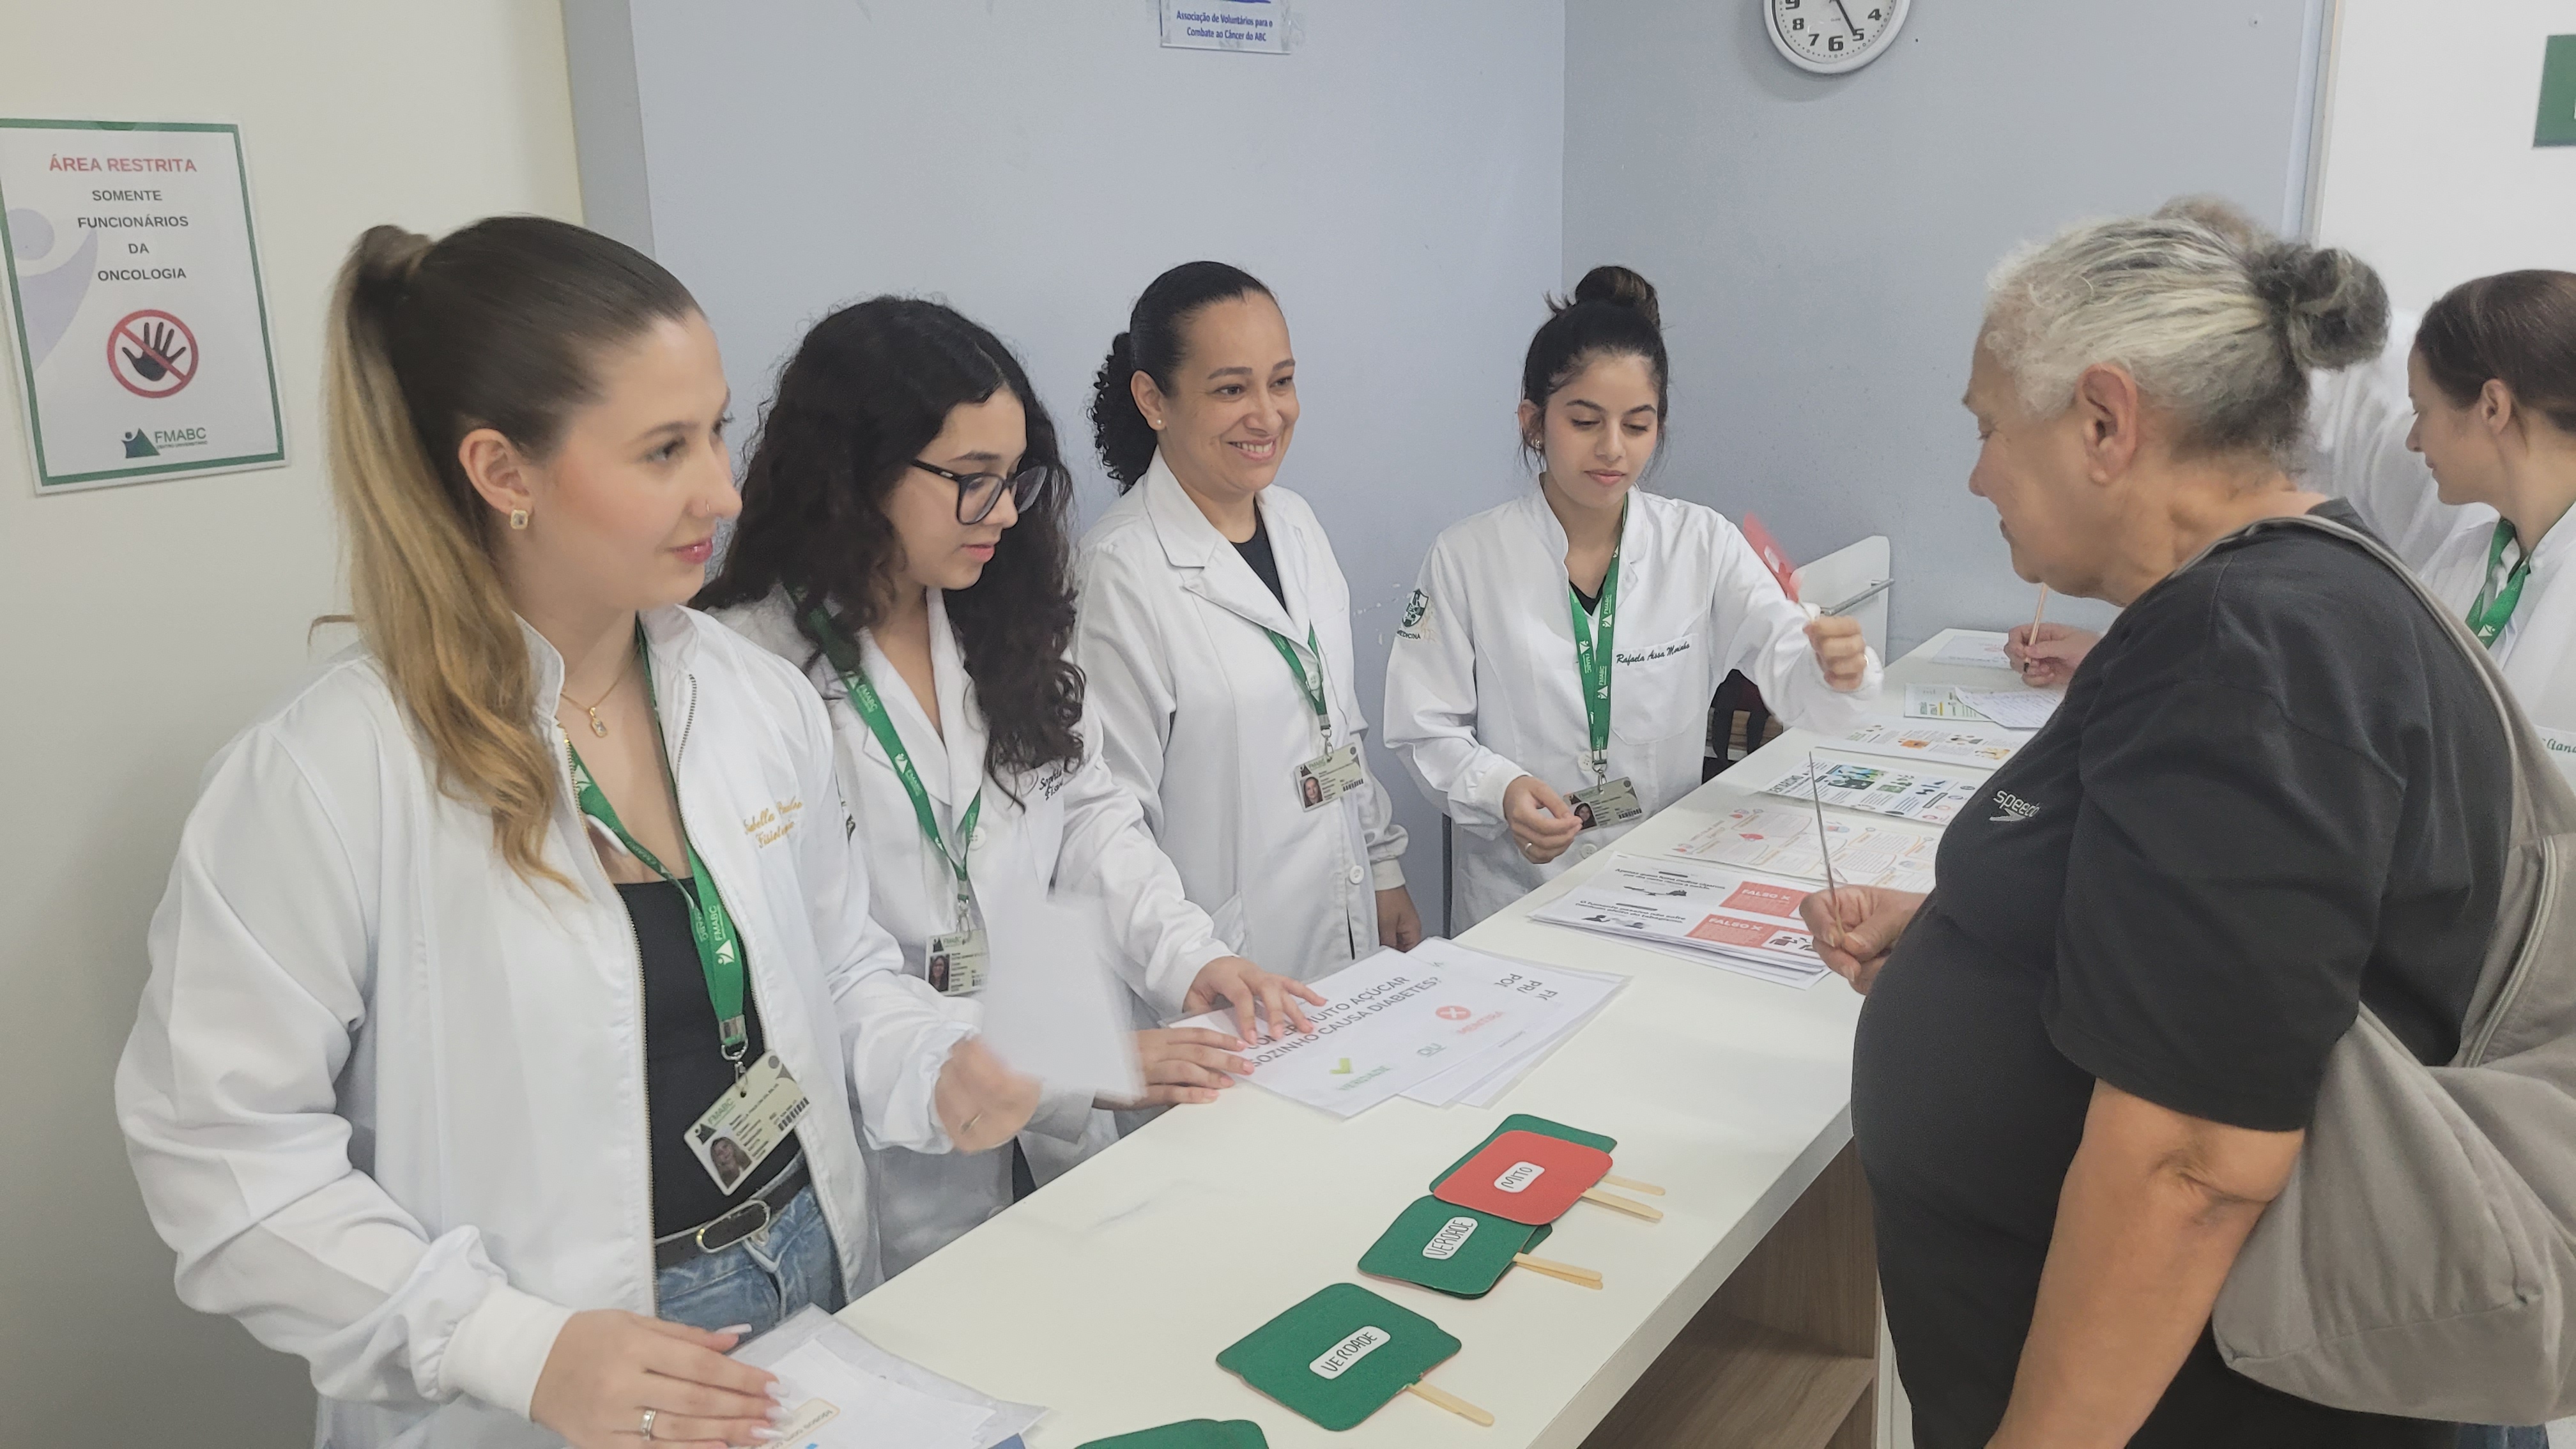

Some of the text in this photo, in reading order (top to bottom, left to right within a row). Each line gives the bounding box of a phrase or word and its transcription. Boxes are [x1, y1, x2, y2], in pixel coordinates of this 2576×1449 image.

[1176, 10, 1210, 24] Associação
[1211, 13, 1220, 22] de
[1220, 14, 1254, 26] Voluntários
[1255, 19, 1268, 28] para
[1867, 8, 1882, 20] 4
[1793, 18, 1804, 30] 8
[1187, 27, 1214, 38] Combate
[1225, 29, 1244, 40] Câncer
[1246, 31, 1253, 40] do
[1255, 33, 1266, 41] ABC
[1809, 33, 1820, 46] 7
[1853, 28, 1864, 41] 5
[1828, 35, 1844, 52] 6
[49, 154, 197, 172] ÁREA RESTRITA
[92, 190, 162, 201] SOMENTE
[77, 214, 188, 229] FUNCIONÁRIOS
[128, 243, 150, 254] DA
[98, 268, 187, 282] ONCOLOGIA
[154, 427, 206, 443] FMABC
[1742, 889, 1778, 899] FALSO
[709, 905, 723, 941] FMABC
[1708, 917, 1750, 929] FALSO
[1350, 977, 1410, 1005] AÇÚCAR
[1318, 1010, 1373, 1034] CAUSA
[1367, 977, 1441, 1011] DIABETES?
[1417, 1043, 1446, 1057] OU
[1501, 1167, 1533, 1190] MITO
[1425, 1220, 1474, 1257] VERDADE
[1321, 1331, 1377, 1372] VERDADE
